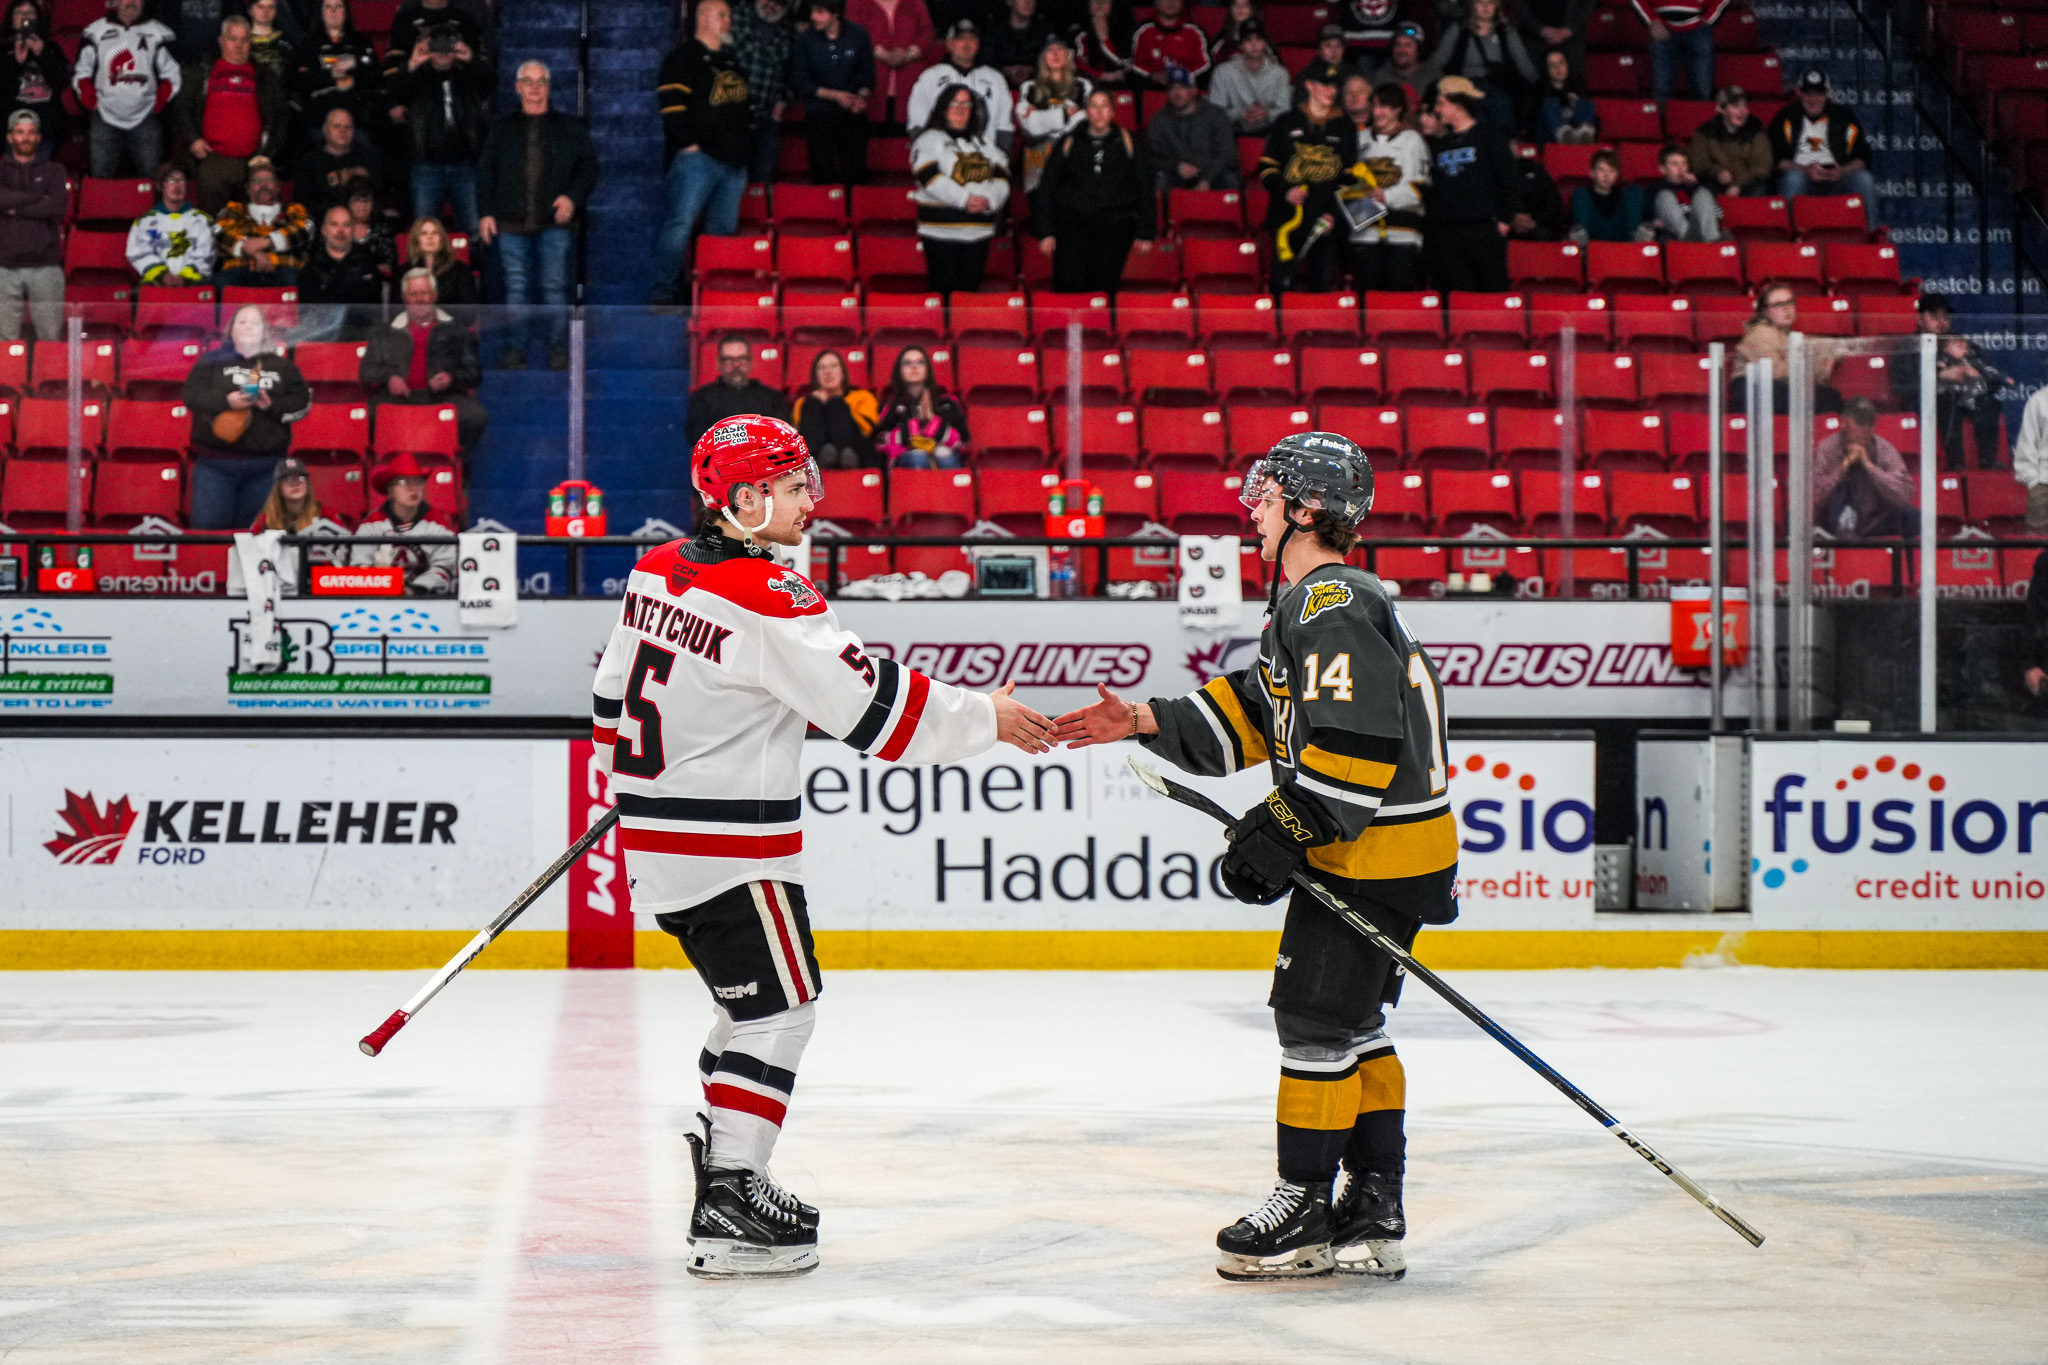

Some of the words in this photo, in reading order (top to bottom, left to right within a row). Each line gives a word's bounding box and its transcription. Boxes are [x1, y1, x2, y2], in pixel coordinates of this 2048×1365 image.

[713, 424, 747, 437] SASK
[714, 431, 747, 443] PROMO
[567, 519, 585, 538] G
[1068, 519, 1086, 538] G
[56, 571, 74, 589] G
[318, 575, 393, 588] GATORADE
[672, 562, 699, 578] CCM
[1304, 593, 1350, 620] Kings
[622, 591, 734, 665] MTEYCHUK
[839, 643, 876, 689] 5
[905, 643, 1006, 687] BUS
[1006, 643, 1153, 688] LINES
[1302, 653, 1353, 702] 14
[1480, 643, 1594, 687] BUS
[44, 680, 107, 691] SYSTEMS
[233, 680, 339, 691] UNDERGROUND
[343, 680, 420, 691] SPRINKLER
[423, 680, 484, 691] SYSTEMS
[337, 699, 408, 708] WATER
[414, 699, 438, 708] TO
[612, 639, 677, 781] 5
[1407, 652, 1448, 796] 1
[806, 754, 1073, 836] eignen
[142, 800, 458, 845] KELLEHER
[138, 847, 205, 865] FORD
[1856, 870, 1960, 899] credit
[1972, 871, 2048, 899] unio
[708, 1209, 744, 1237] CCM
